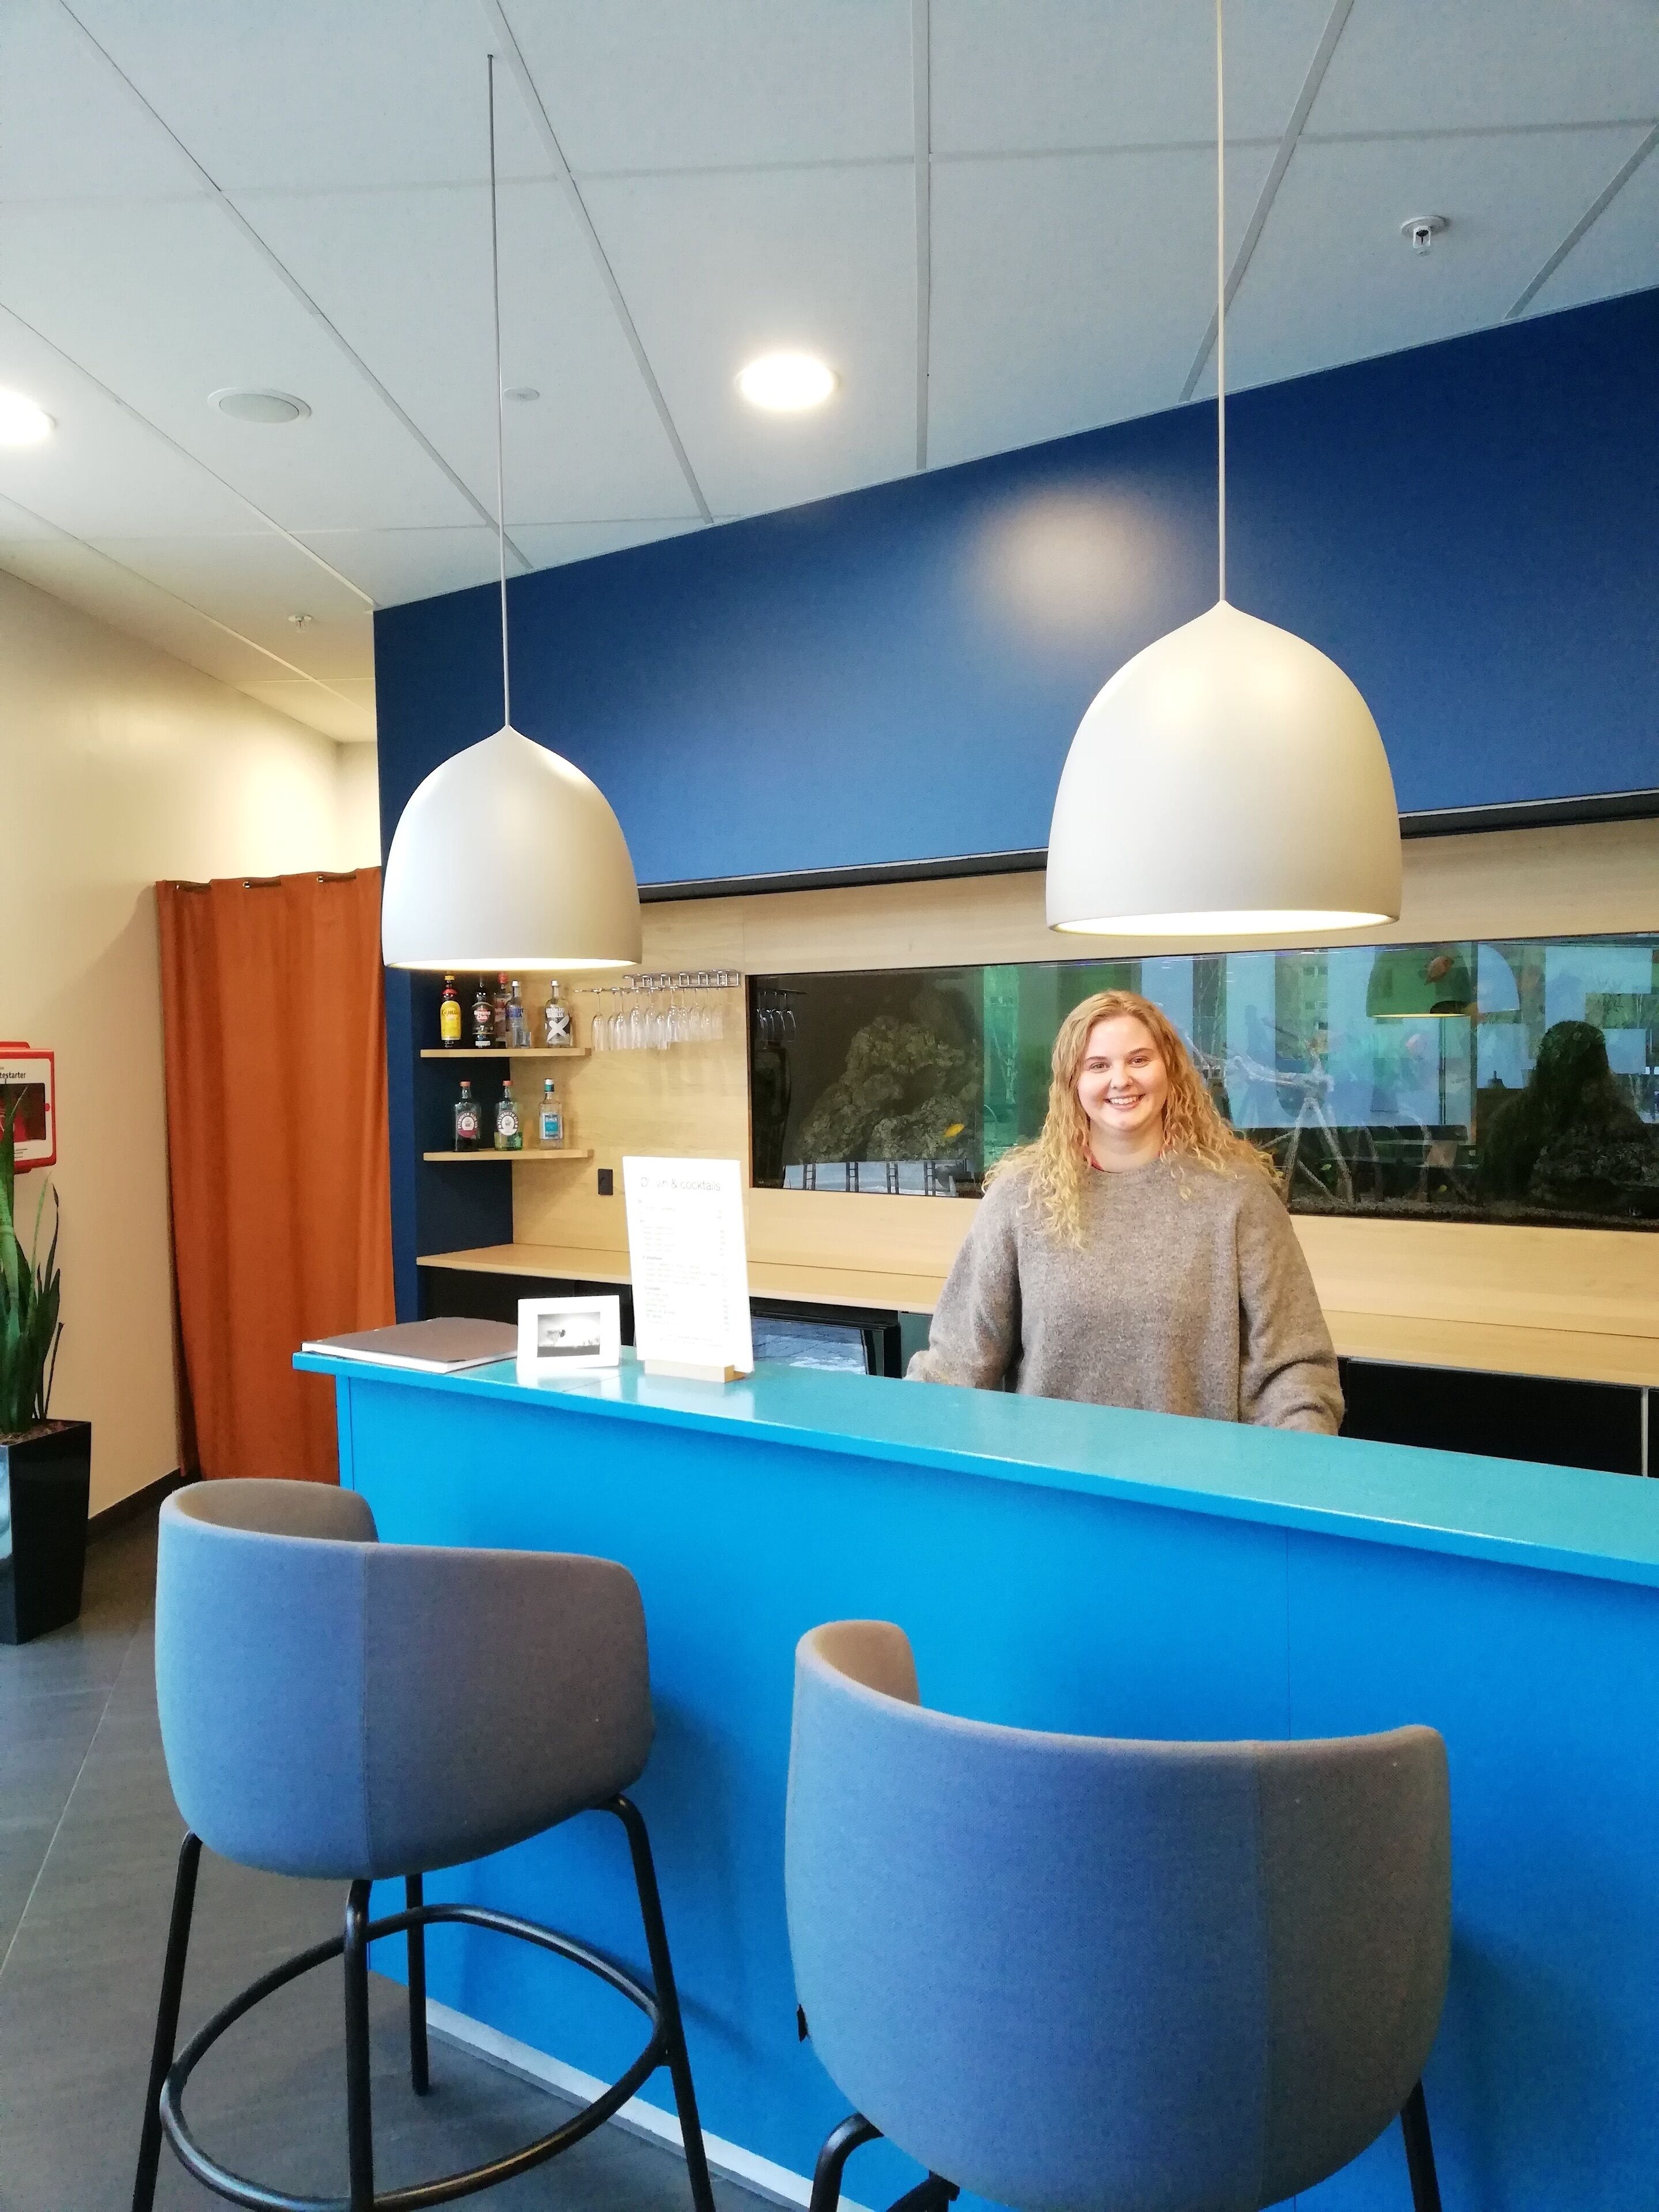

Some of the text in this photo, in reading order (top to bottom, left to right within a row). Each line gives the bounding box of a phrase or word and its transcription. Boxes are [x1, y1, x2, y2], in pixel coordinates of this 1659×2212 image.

[498, 1112, 515, 1125] PLYMOUTH
[671, 1179, 677, 1190] &
[680, 1180, 721, 1191] cocktails
